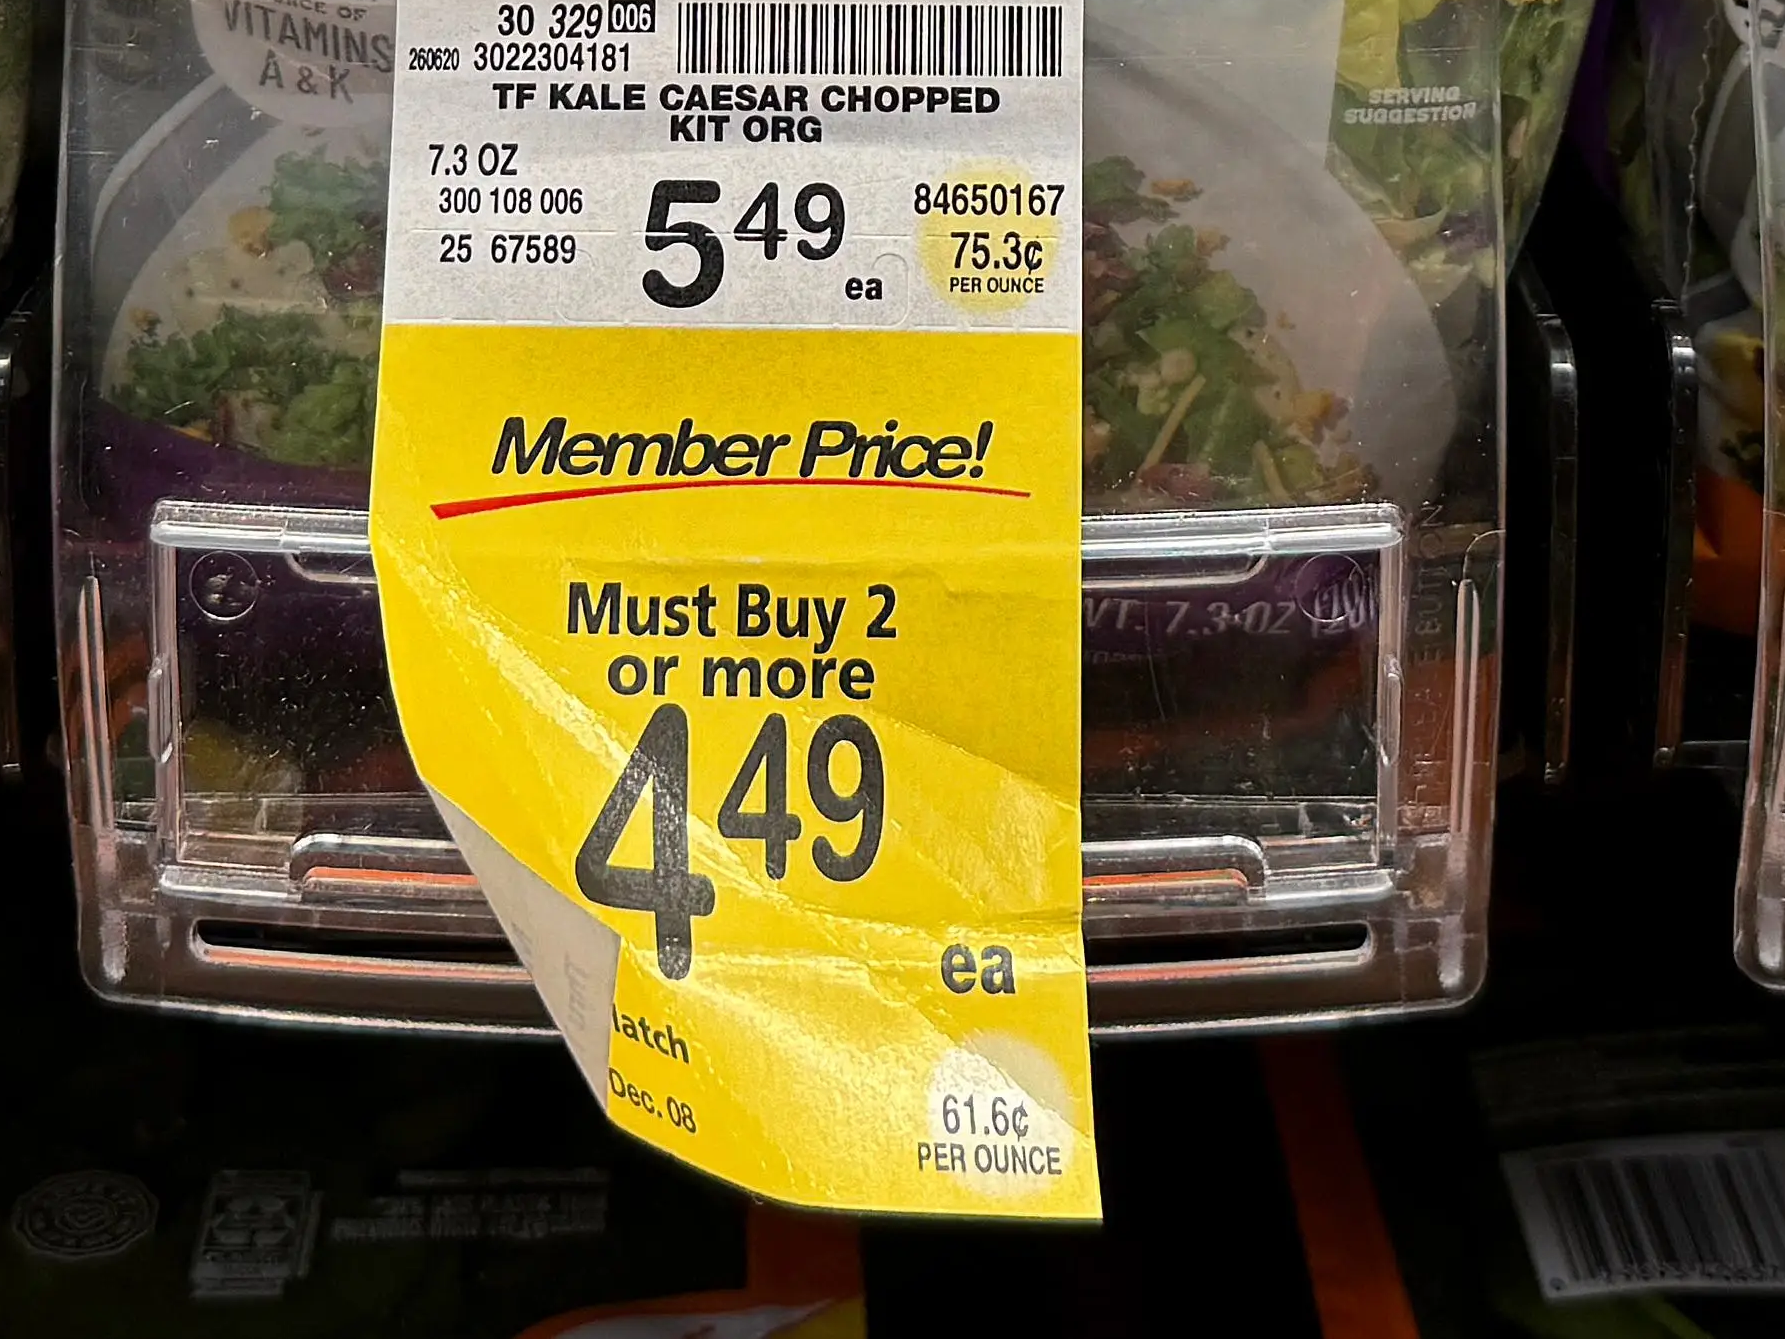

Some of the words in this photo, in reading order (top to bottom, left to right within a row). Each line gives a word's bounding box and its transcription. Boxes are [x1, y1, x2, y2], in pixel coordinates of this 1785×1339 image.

[224, 0, 394, 72] VITAMINS
[474, 43, 630, 72] 3022304181
[494, 84, 535, 109] TF
[550, 84, 646, 111] KALE
[660, 85, 808, 111] CAESAR
[821, 87, 1000, 113] CHOPPED
[1369, 86, 1461, 104] SERVING
[1344, 102, 1476, 124] SUGGESTION
[670, 117, 732, 142] KIT
[742, 117, 823, 143] ORG
[914, 185, 1065, 216] 84650167
[950, 232, 1043, 272] 75.3¢
[941, 1093, 1029, 1139] 61.6¢
